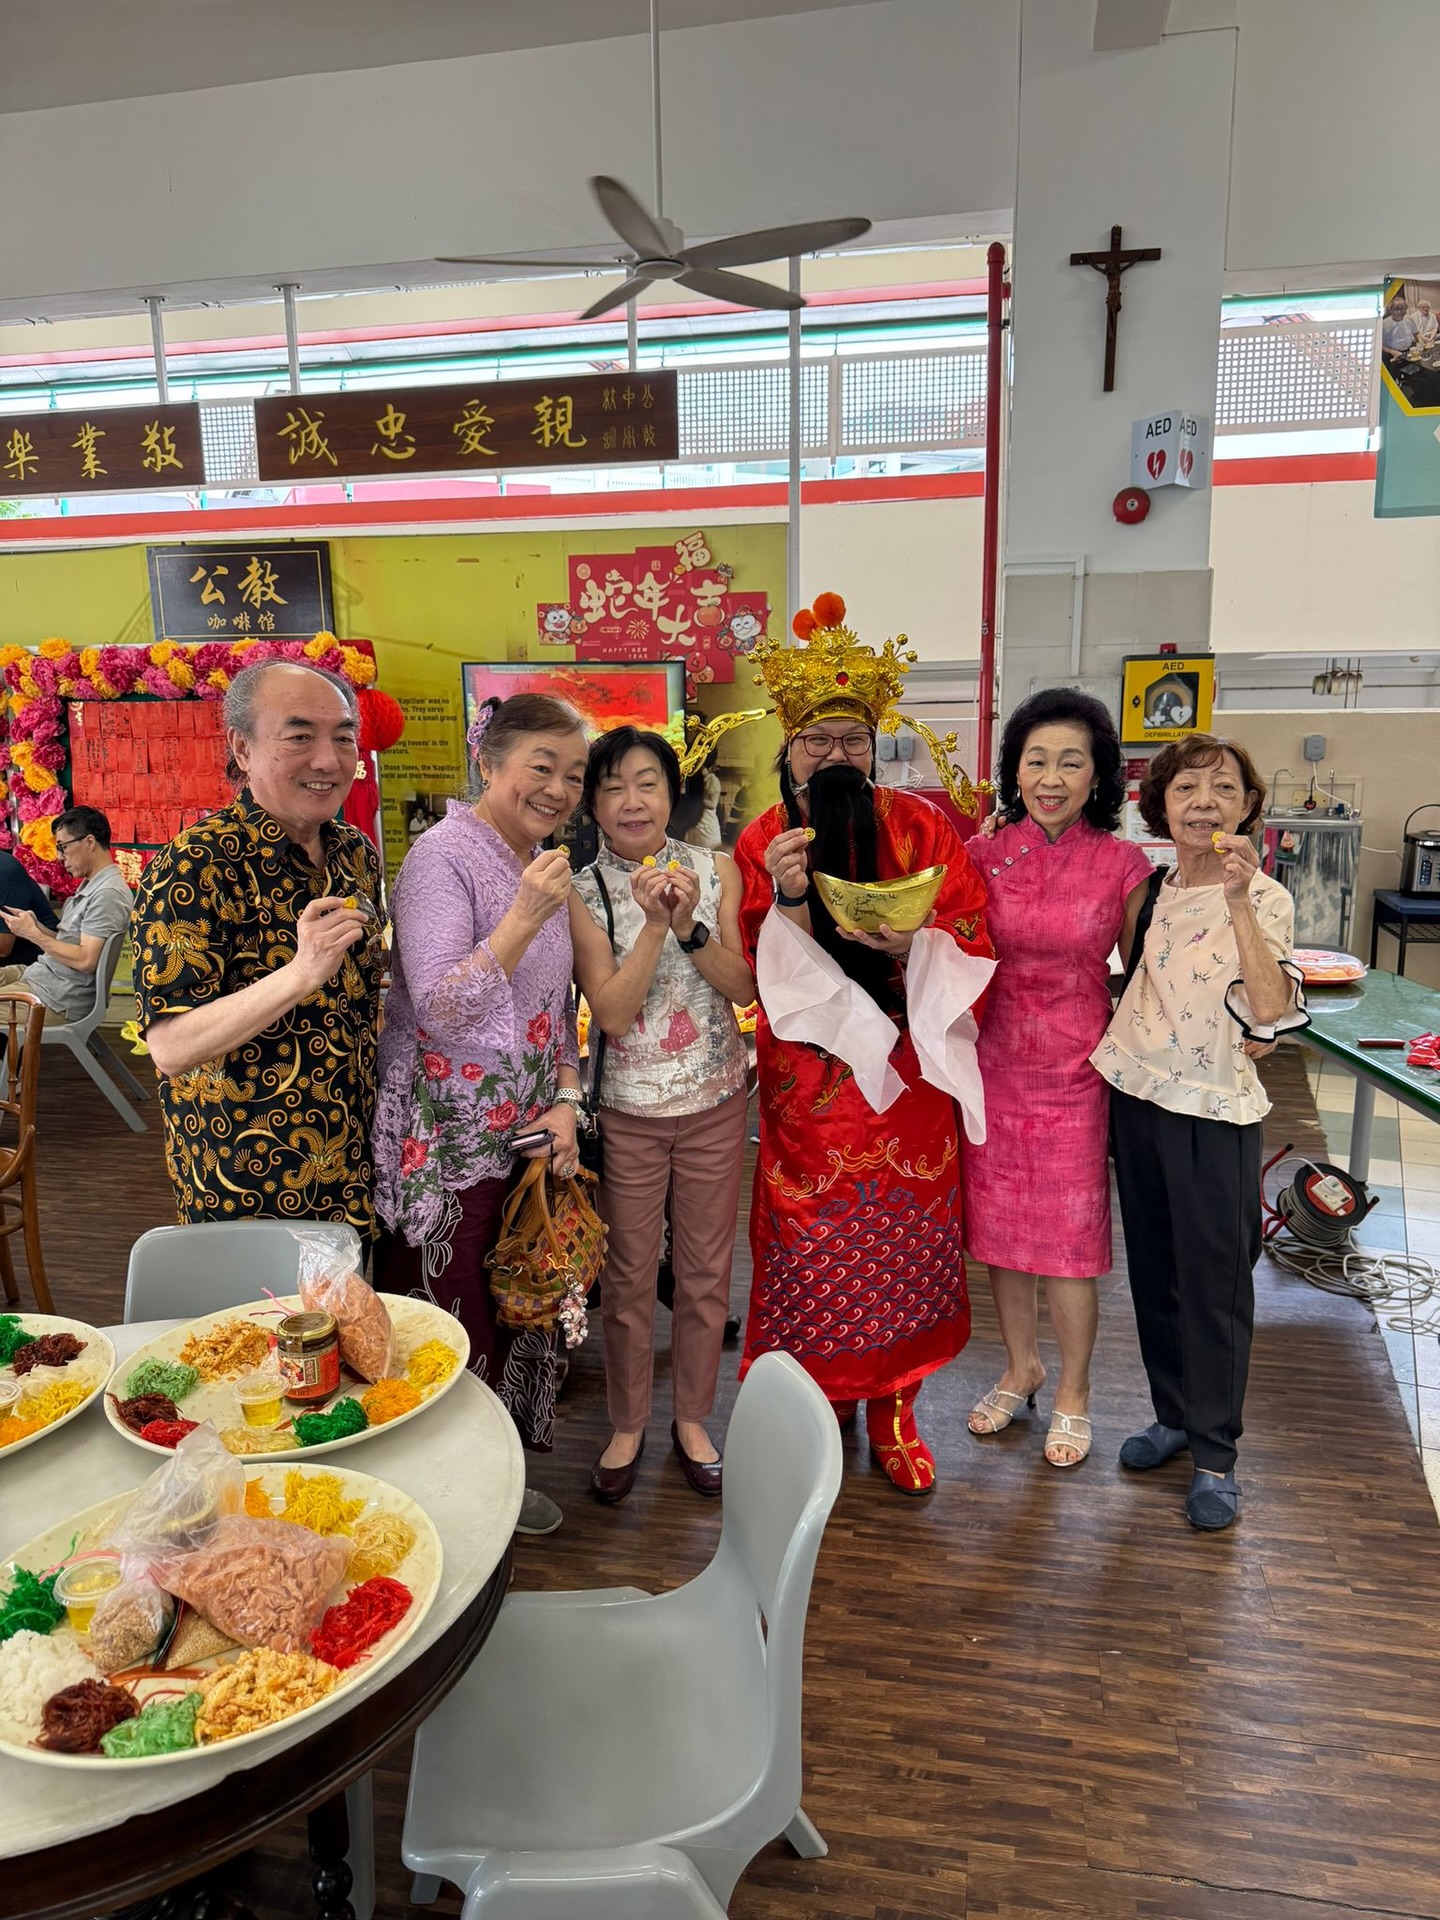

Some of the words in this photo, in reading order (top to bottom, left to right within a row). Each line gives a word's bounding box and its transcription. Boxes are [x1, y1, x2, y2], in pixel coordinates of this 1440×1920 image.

[1146, 417, 1172, 439] AED
[1179, 417, 1197, 437] AED
[189, 556, 289, 609] 公教
[207, 610, 276, 632] 咖啡馆
[1162, 662, 1185, 671] AED
[412, 706, 425, 714] They
[440, 715, 458, 723] group
